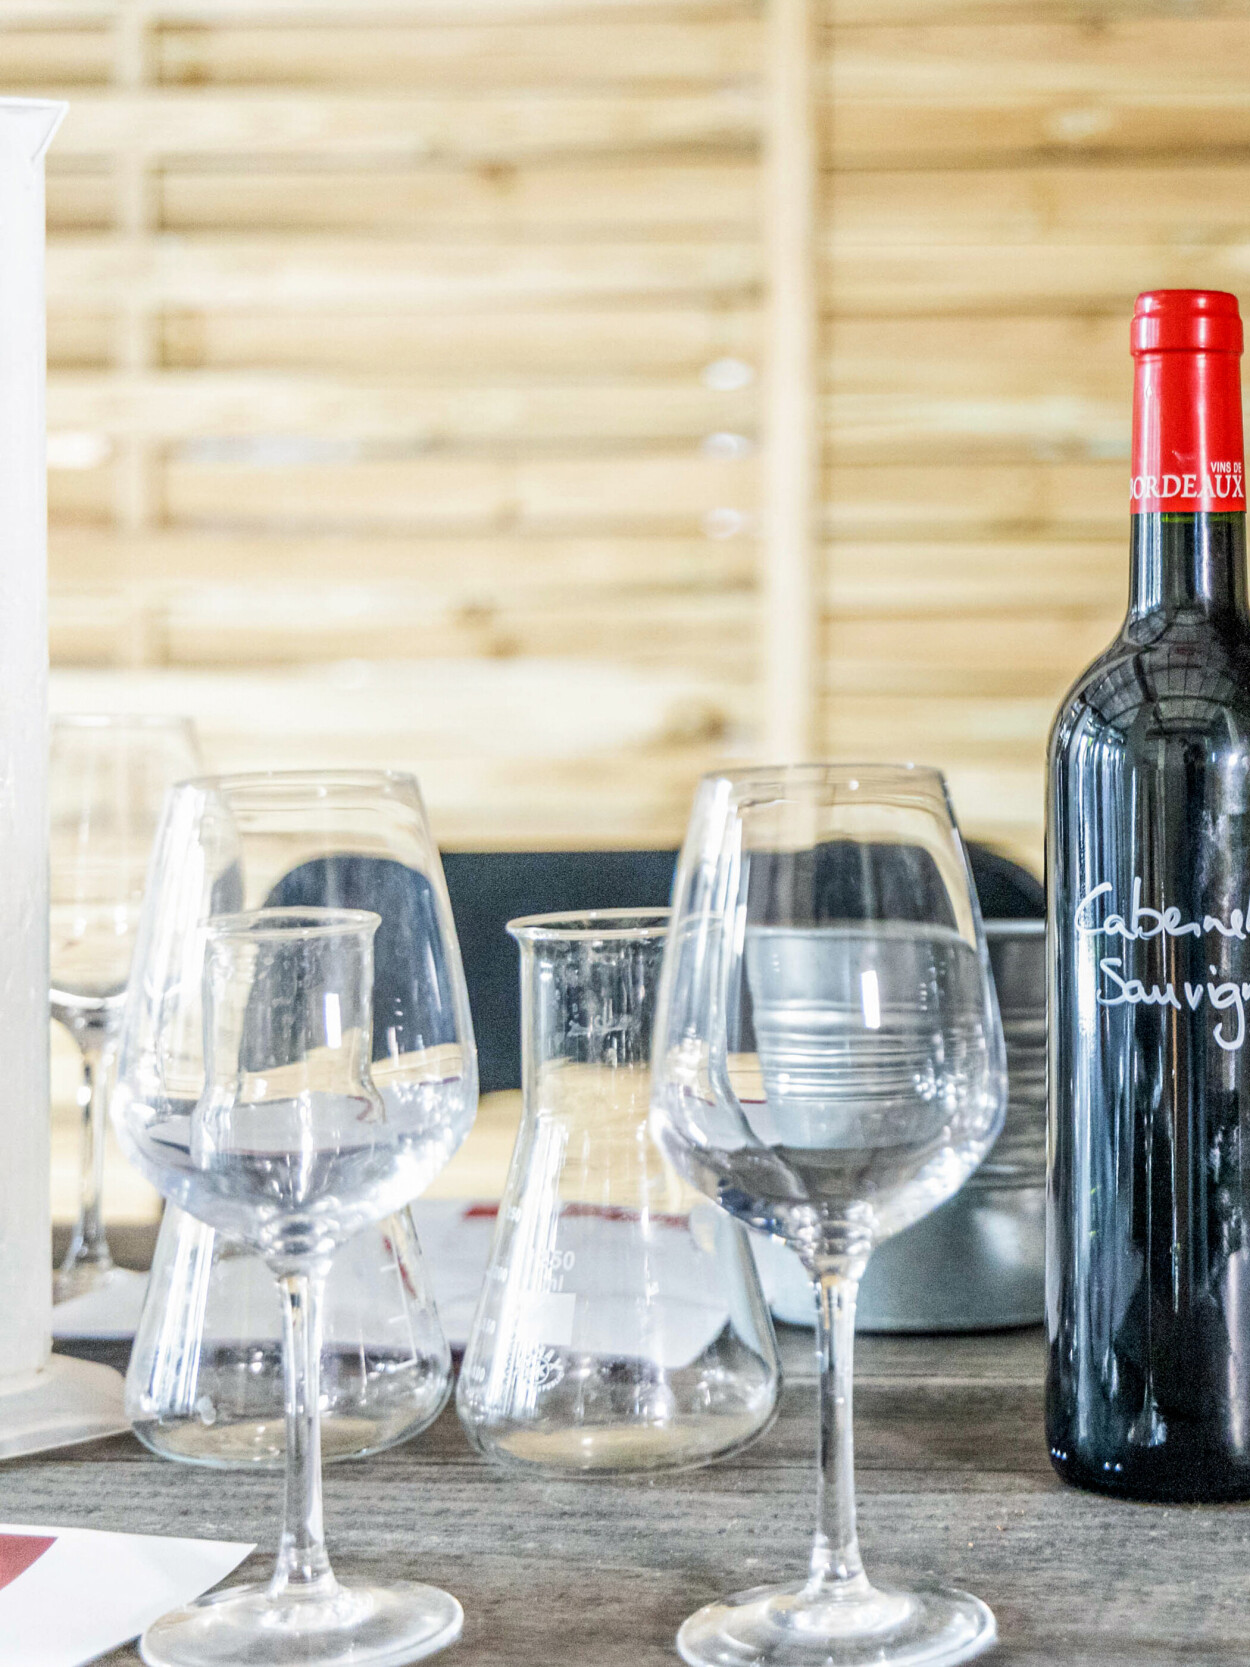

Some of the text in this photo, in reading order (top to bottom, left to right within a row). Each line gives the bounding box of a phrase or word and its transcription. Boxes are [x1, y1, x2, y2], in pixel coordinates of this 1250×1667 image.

[1210, 461, 1242, 473] VINS DE
[1130, 474, 1244, 499] BORDEAUX
